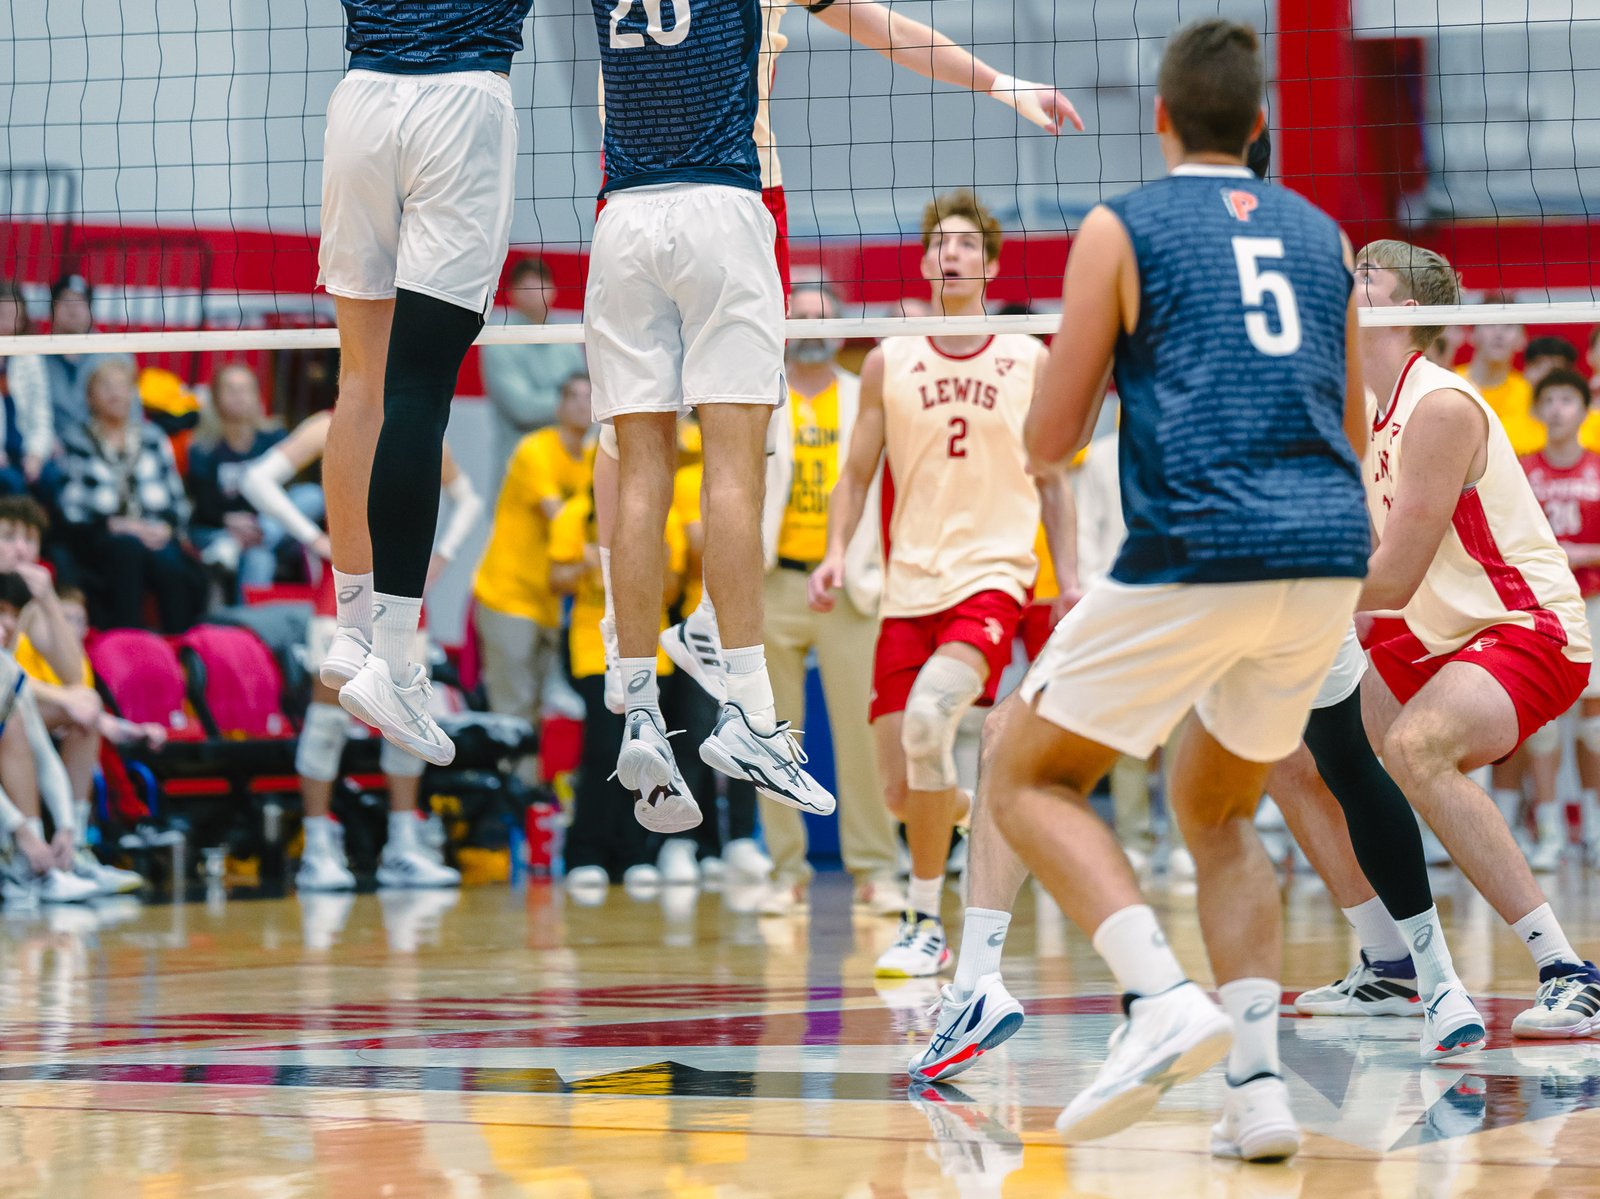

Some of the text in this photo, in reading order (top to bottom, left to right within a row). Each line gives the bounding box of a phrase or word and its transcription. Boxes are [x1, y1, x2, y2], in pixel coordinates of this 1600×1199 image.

[1231, 236, 1303, 357] 5
[919, 377, 998, 410] LEWIS
[947, 416, 968, 458] 2
